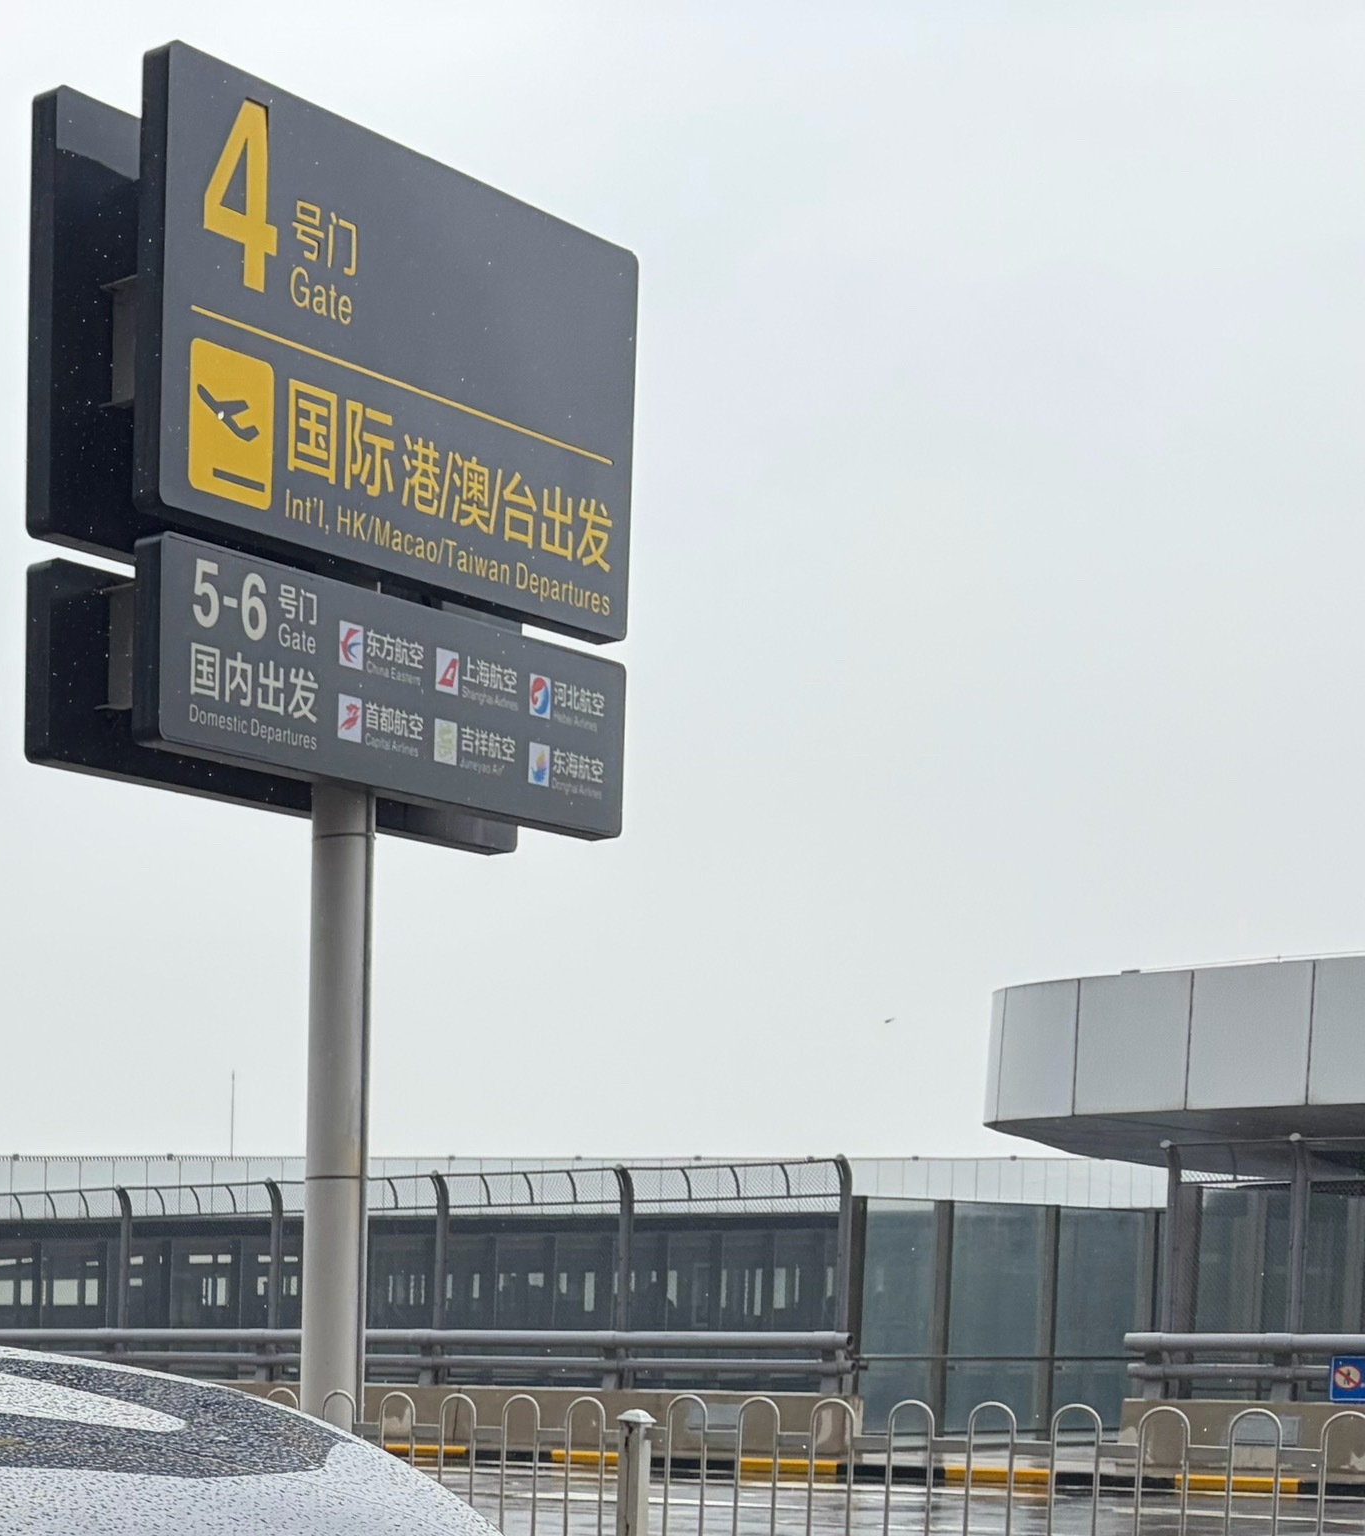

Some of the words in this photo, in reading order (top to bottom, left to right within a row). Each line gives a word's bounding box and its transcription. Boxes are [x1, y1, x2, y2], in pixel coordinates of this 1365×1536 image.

[203, 100, 278, 293] 4
[292, 199, 358, 276] 号门
[290, 266, 353, 325] Gate
[336, 505, 510, 587] HK/Macao/Taiwan
[515, 562, 612, 617] Departures
[192, 557, 268, 642] 5-6
[277, 583, 318, 626] 号门
[277, 622, 317, 655] Gate
[366, 629, 424, 670] 东方航空
[190, 641, 319, 724] 国内出发
[462, 655, 518, 694] 上海航空
[554, 681, 605, 717] 河北航空
[188, 703, 248, 735] Domestic
[250, 717, 318, 751] Departures
[365, 701, 424, 741] 首都航空
[460, 726, 516, 762] 吉祥航空
[552, 748, 604, 783] 东海航空
